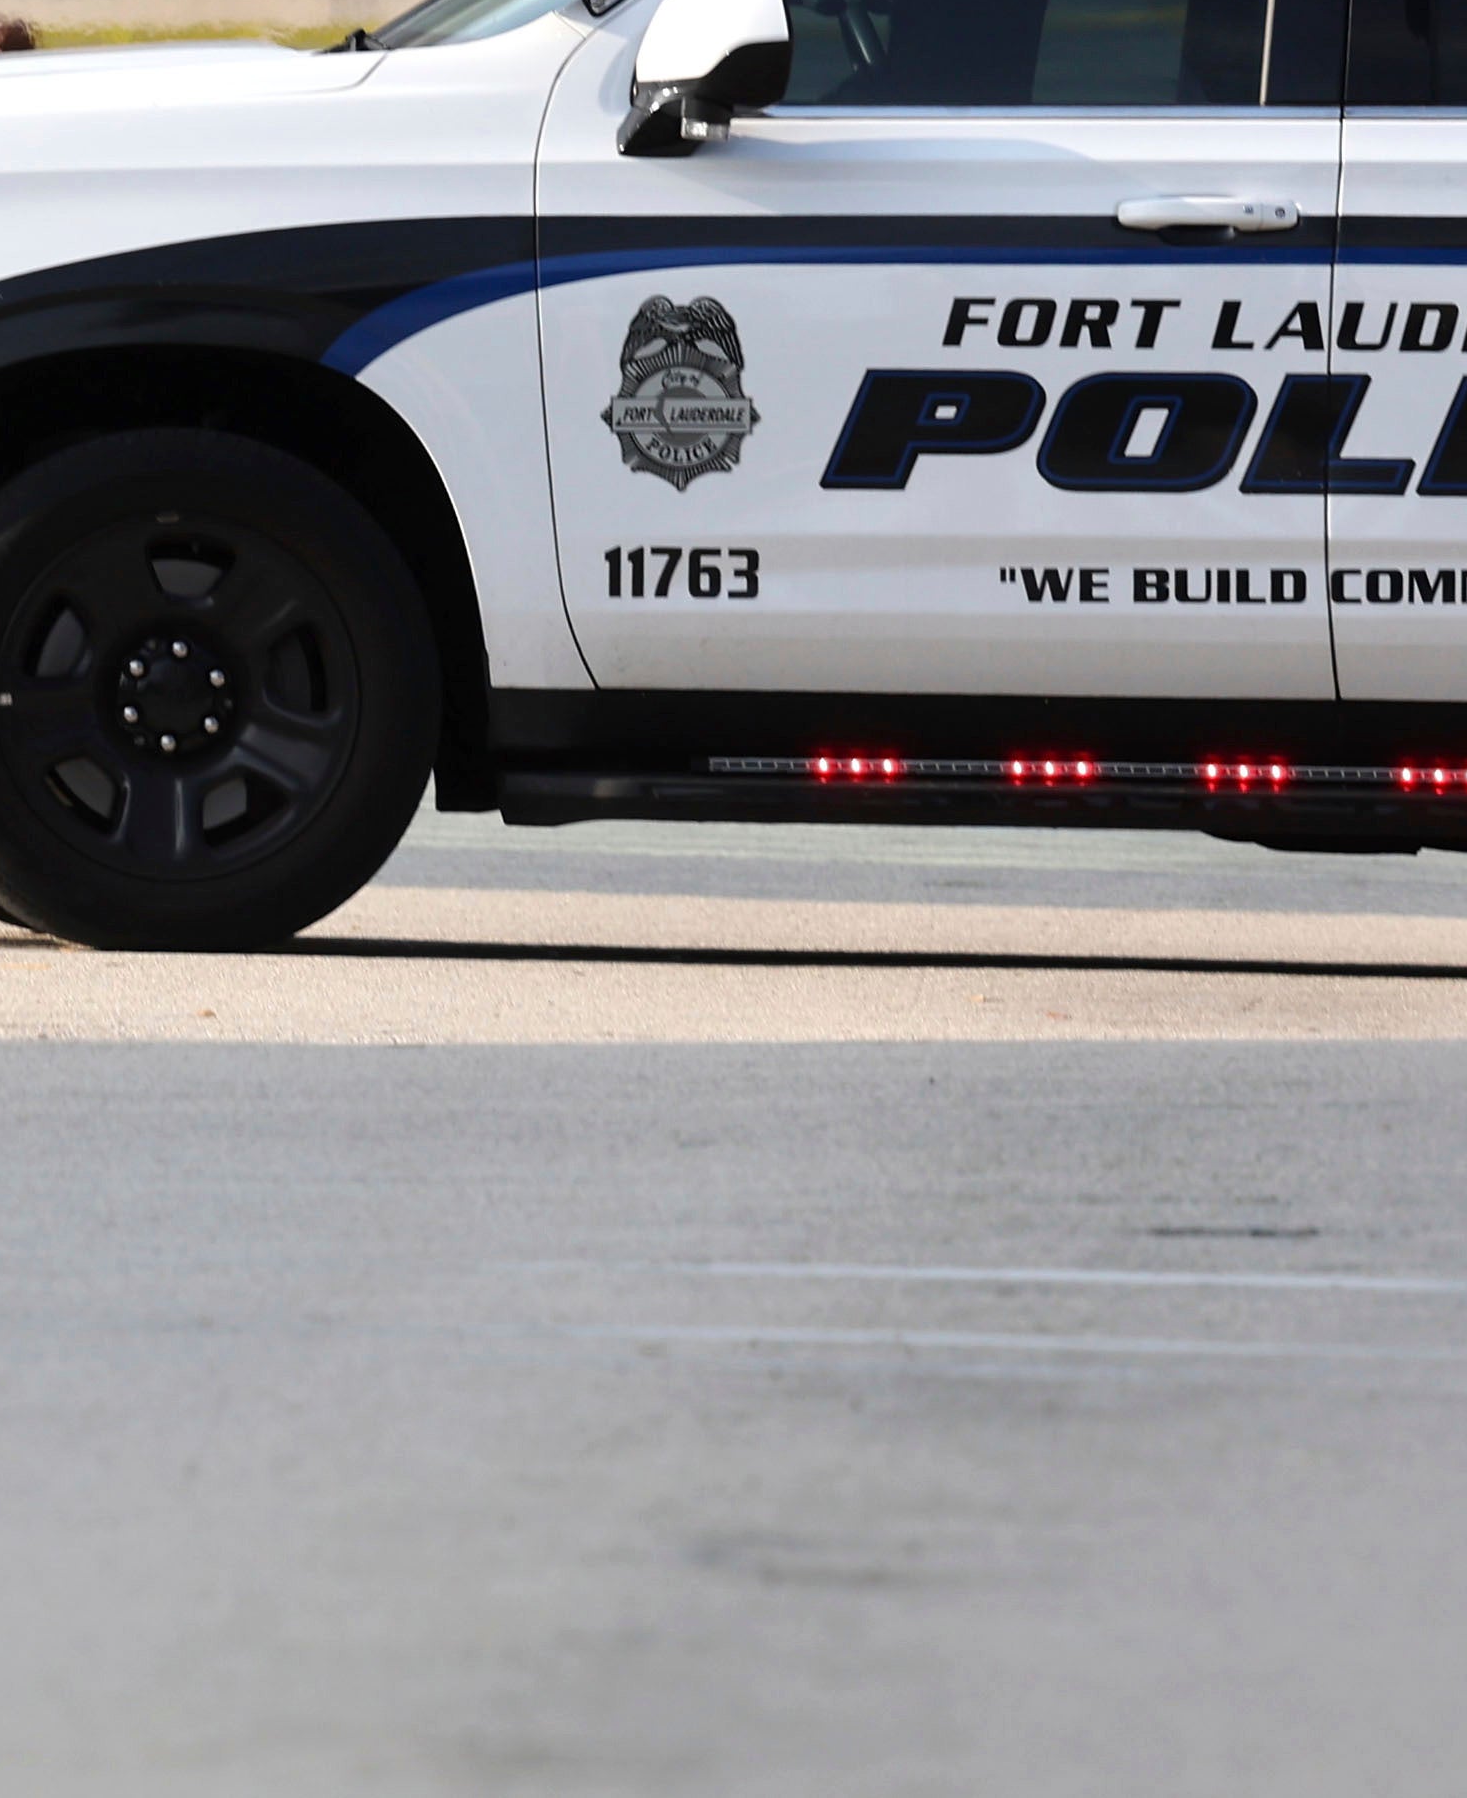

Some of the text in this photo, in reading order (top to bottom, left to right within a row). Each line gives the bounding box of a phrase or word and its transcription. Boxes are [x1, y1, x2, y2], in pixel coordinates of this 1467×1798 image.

[941, 296, 1181, 349] FORT
[623, 406, 745, 423] FORT LAUDERDALE
[645, 436, 718, 464] POLICE
[604, 546, 760, 599] 11763
[999, 566, 1111, 603] "WE
[1132, 568, 1307, 604] BUILD
